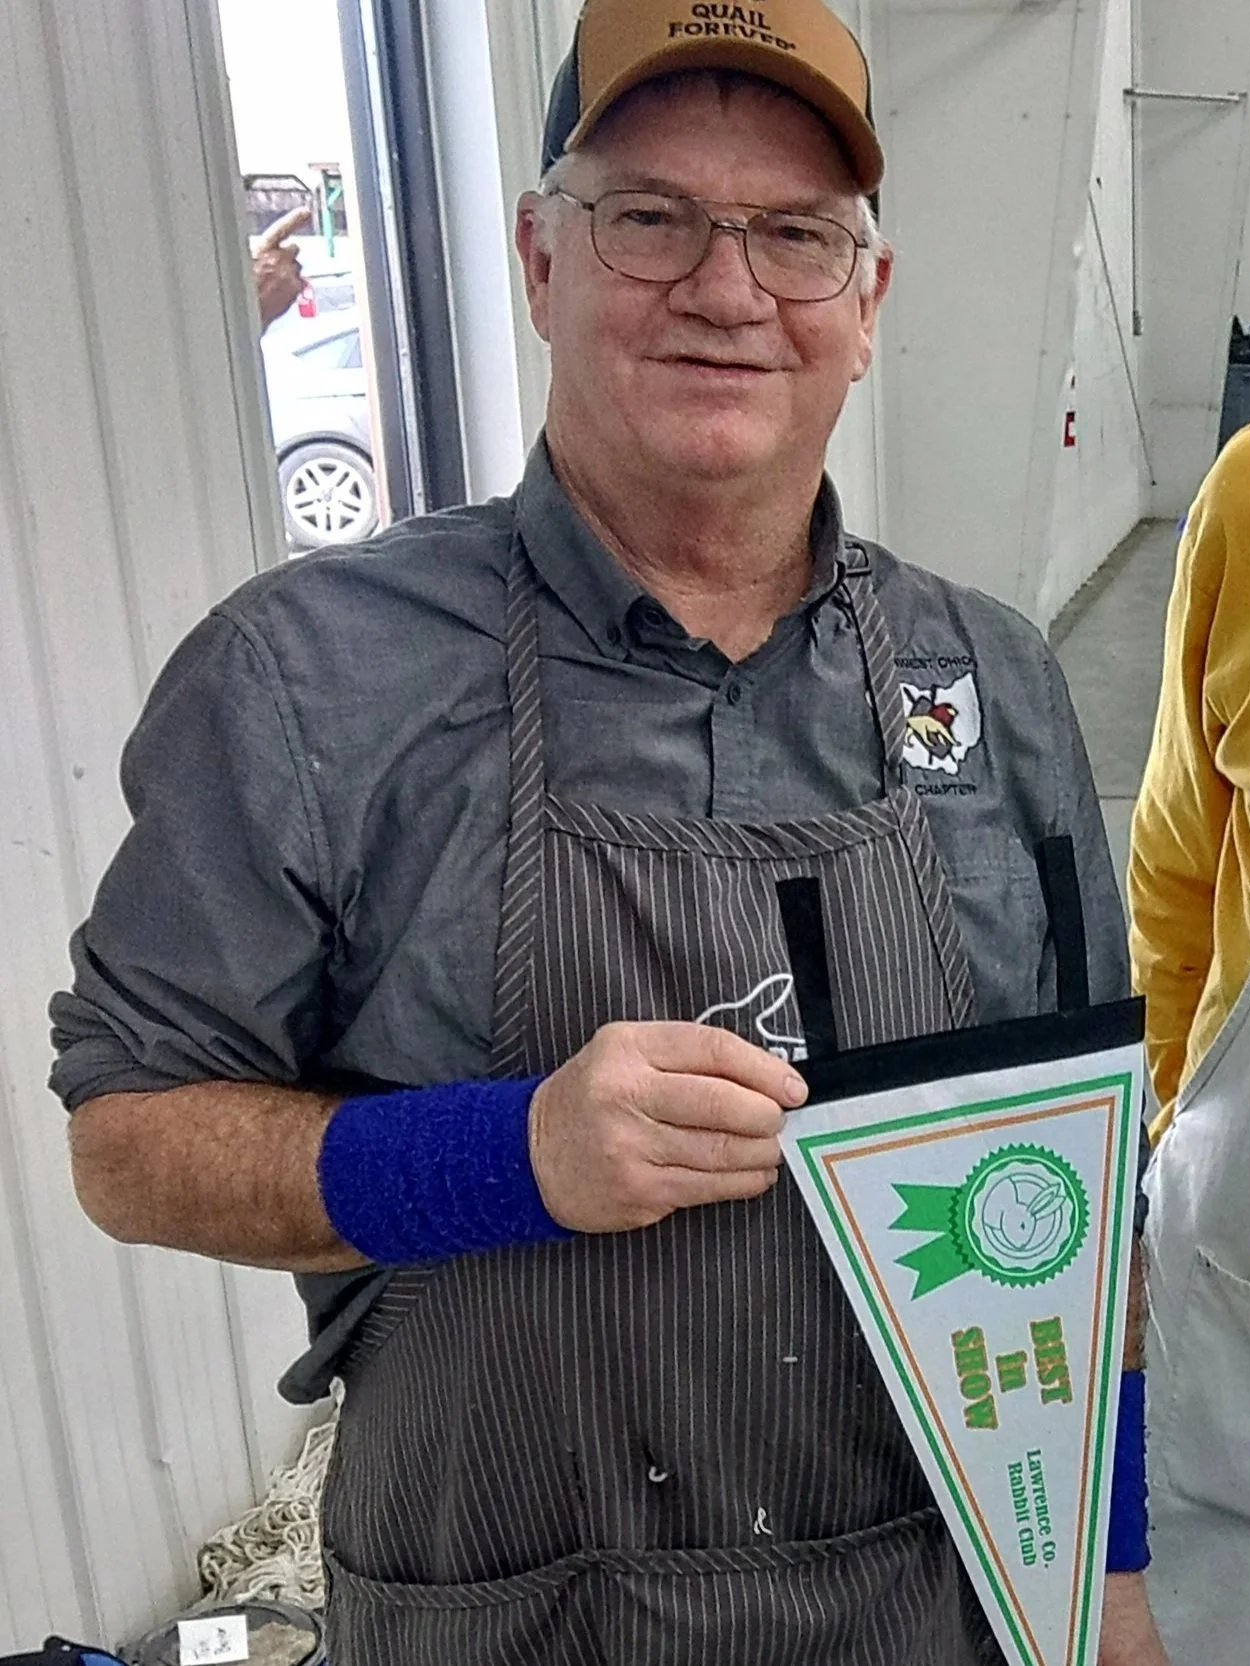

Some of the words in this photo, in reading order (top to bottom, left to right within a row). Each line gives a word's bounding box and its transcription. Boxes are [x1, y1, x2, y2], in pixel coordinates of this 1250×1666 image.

[691, 3, 771, 30] QUAIL
[950, 1325, 999, 1430] SHOW
[1029, 1315, 1074, 1405] BEST
[1007, 1460, 1031, 1523] Rabbit
[1026, 1448, 1054, 1536] Lawrence
[1040, 1541, 1057, 1569] Co.
[1017, 1527, 1037, 1567] Club
